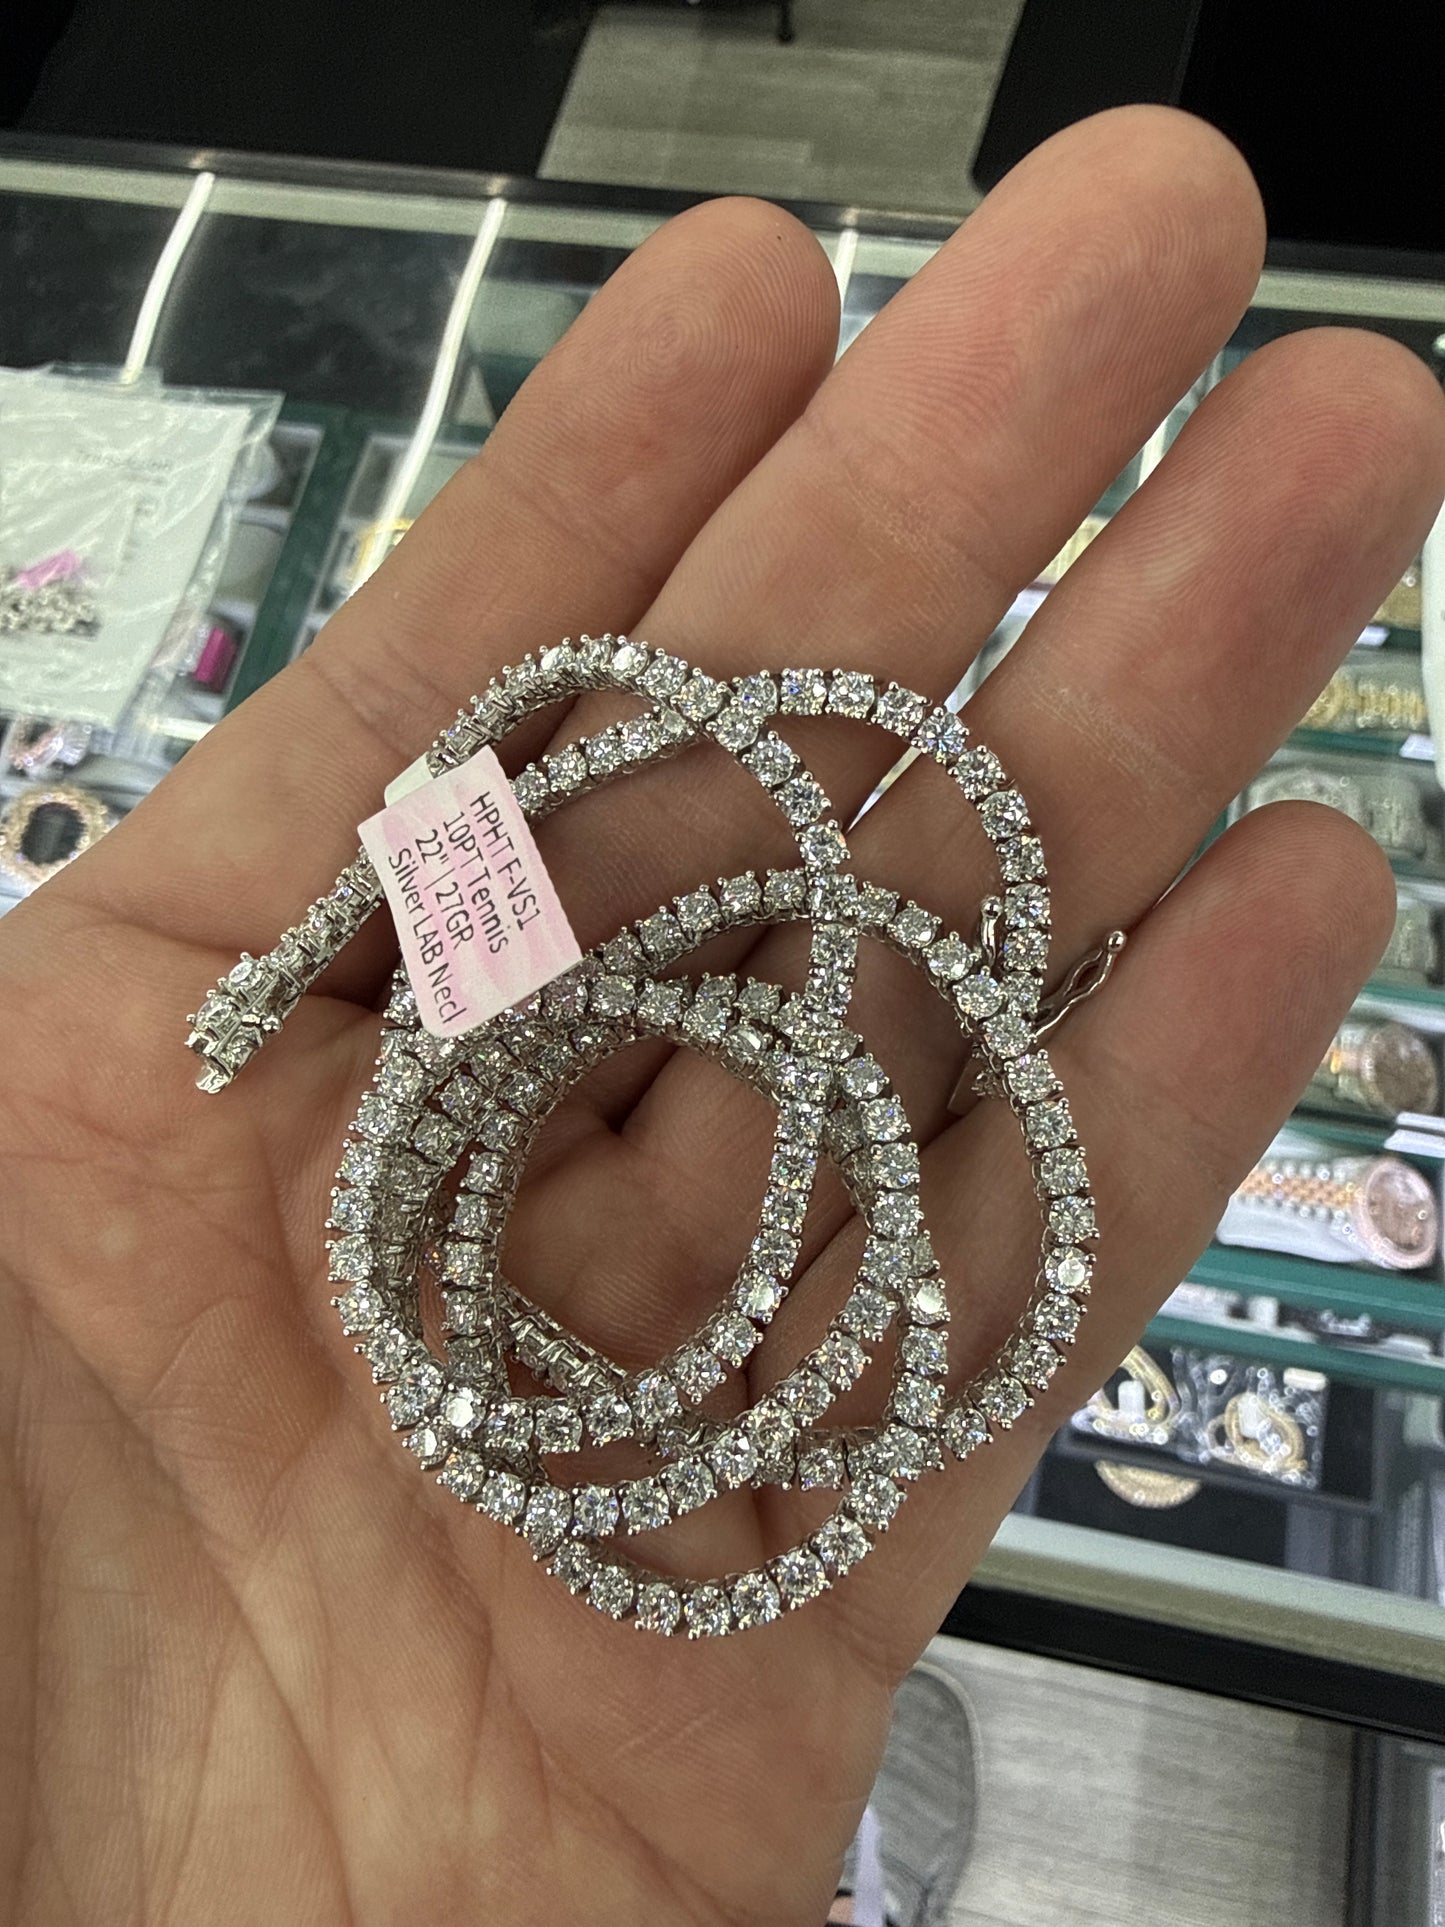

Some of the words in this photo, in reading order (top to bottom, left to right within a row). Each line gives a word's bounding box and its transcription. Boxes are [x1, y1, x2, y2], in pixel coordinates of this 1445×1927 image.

[388, 847, 426, 915] Silver
[415, 828, 449, 864] 22"
[436, 881, 474, 950] 27GR
[443, 811, 484, 869] 10PT
[467, 867, 509, 954] Tennis
[470, 791, 514, 858] HPHT
[497, 857, 541, 931] F-VS1
[414, 913, 444, 965] LAB
[428, 962, 468, 1024] Necl
